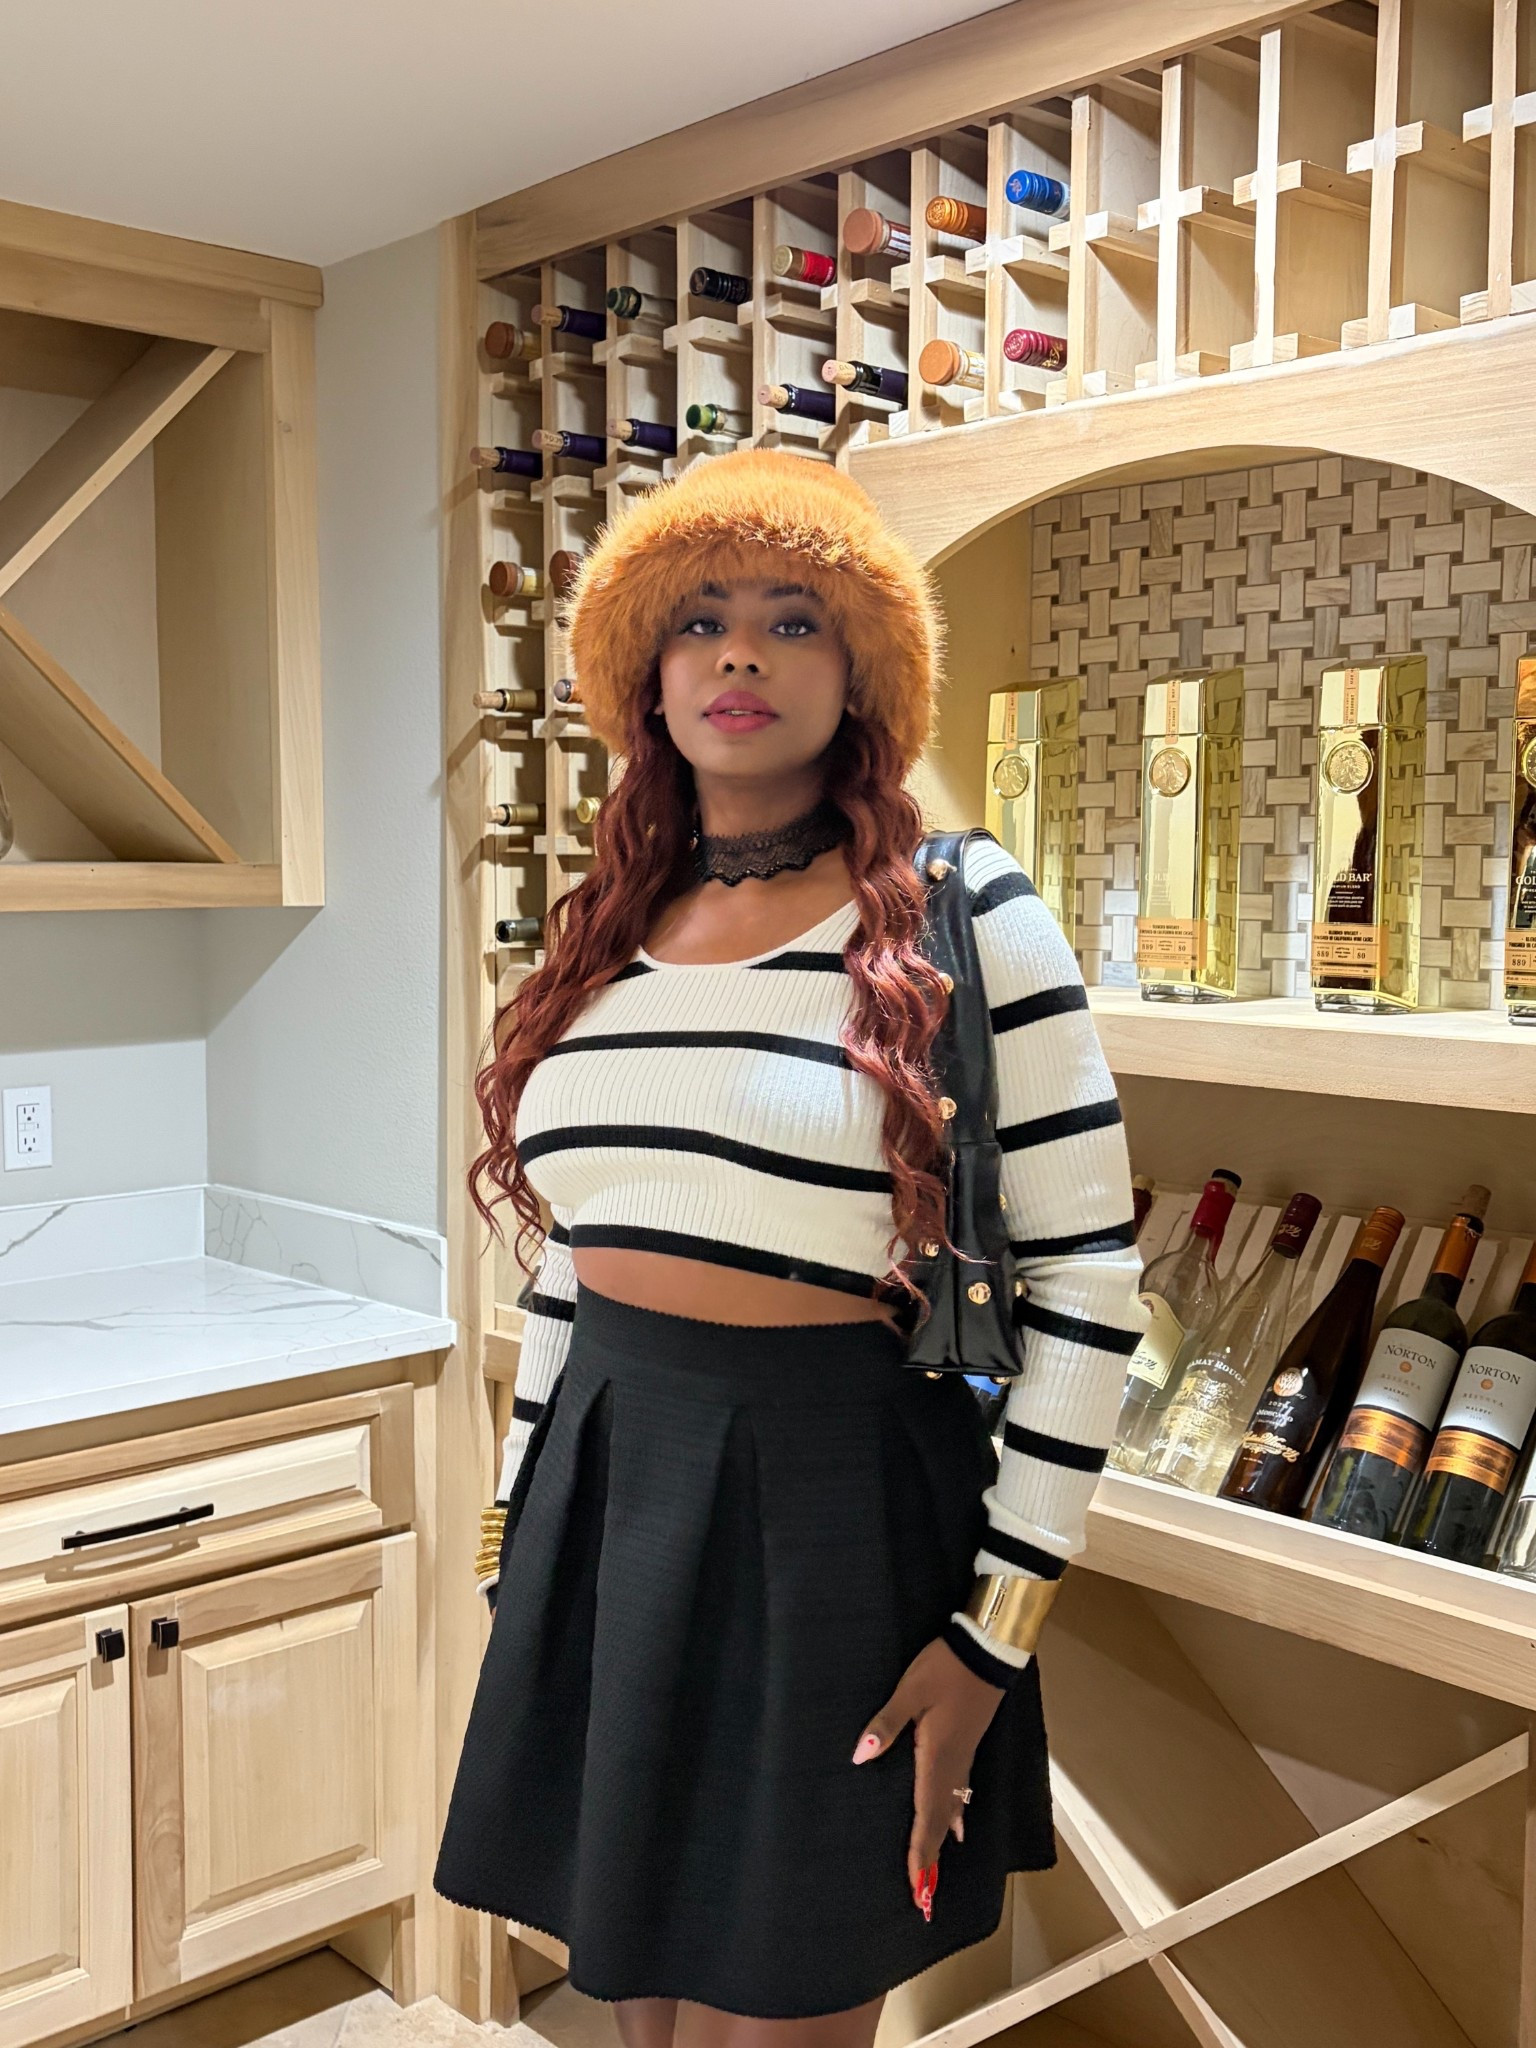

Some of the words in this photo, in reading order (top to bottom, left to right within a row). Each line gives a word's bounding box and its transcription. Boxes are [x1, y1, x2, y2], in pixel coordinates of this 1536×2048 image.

[1348, 873, 1371, 882] BAR
[1515, 875, 1536, 886] GOL
[1316, 950, 1330, 958] 889
[1356, 951, 1366, 959] 80
[1511, 958, 1527, 967] 889
[1384, 1344, 1437, 1370] NORTON
[1214, 1360, 1248, 1386] ROUGE
[1467, 1363, 1521, 1385] NORTON
[1256, 1408, 1294, 1423] MOSCO
